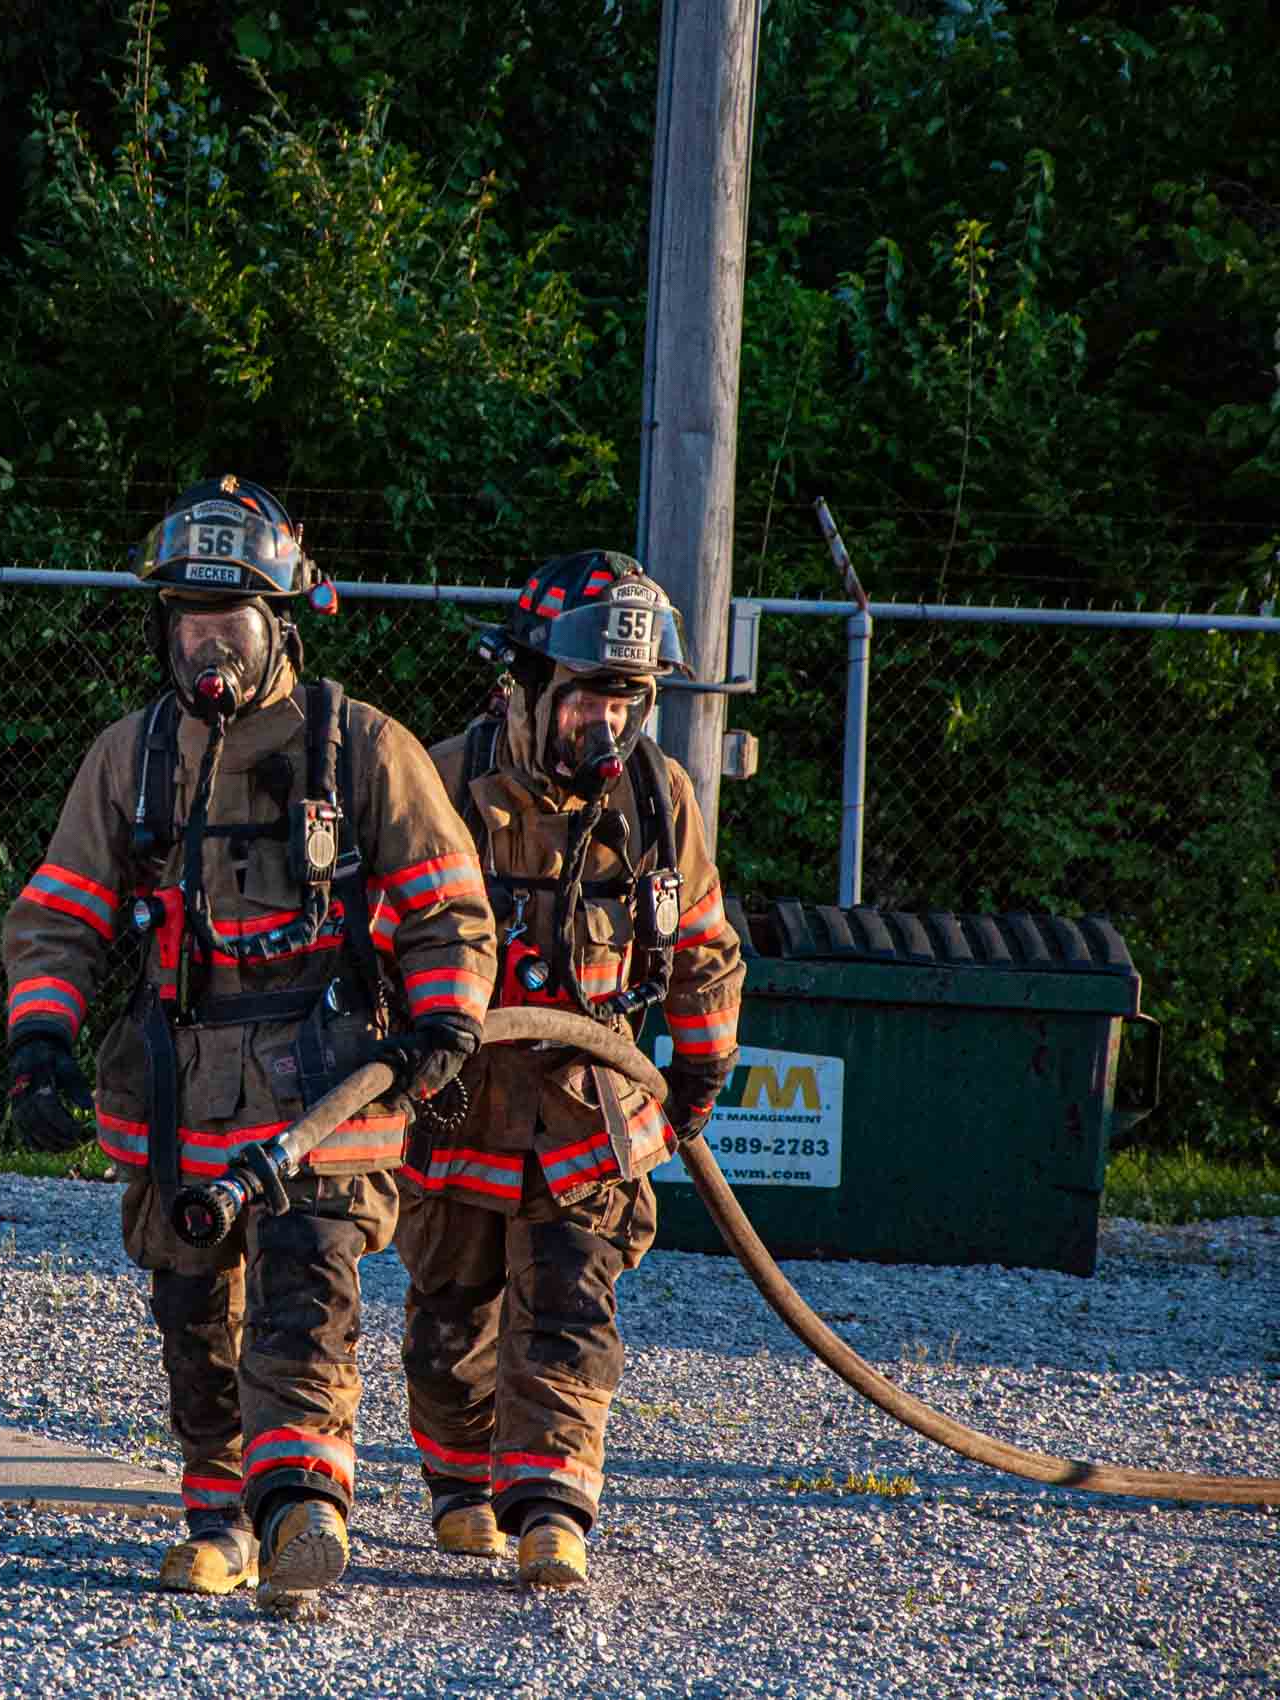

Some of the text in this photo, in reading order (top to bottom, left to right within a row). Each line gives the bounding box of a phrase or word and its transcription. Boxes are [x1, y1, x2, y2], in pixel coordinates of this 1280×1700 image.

[198, 528, 234, 556] 56
[191, 567, 234, 580] HECKER
[617, 585, 652, 601] FIREFIGHTE
[617, 610, 647, 639] 55
[727, 1112, 822, 1124] MANAGEMENT
[705, 1135, 830, 1157] -989-2783
[683, 1167, 811, 1181] .wm.com
